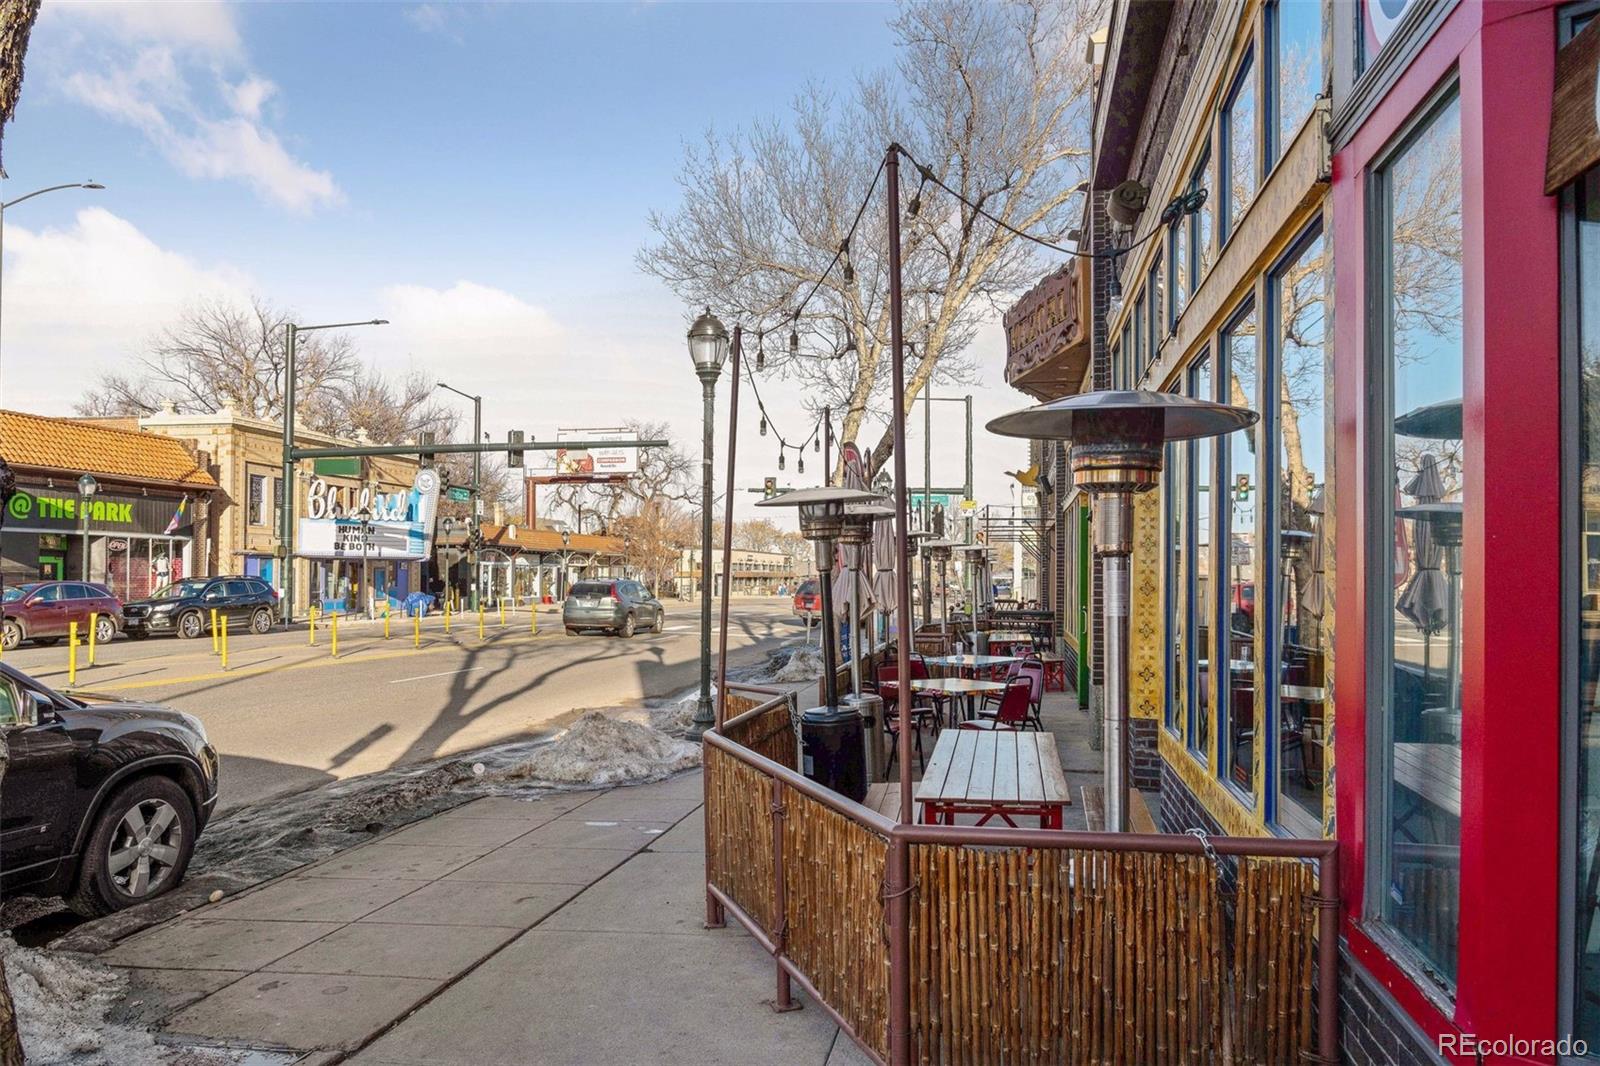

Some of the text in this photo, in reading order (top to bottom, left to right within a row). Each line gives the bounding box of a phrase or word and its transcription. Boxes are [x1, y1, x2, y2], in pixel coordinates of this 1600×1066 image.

[9, 493, 133, 522] @ THE PARK
[338, 525, 375, 535] HUMAN
[334, 542, 347, 551] BE
